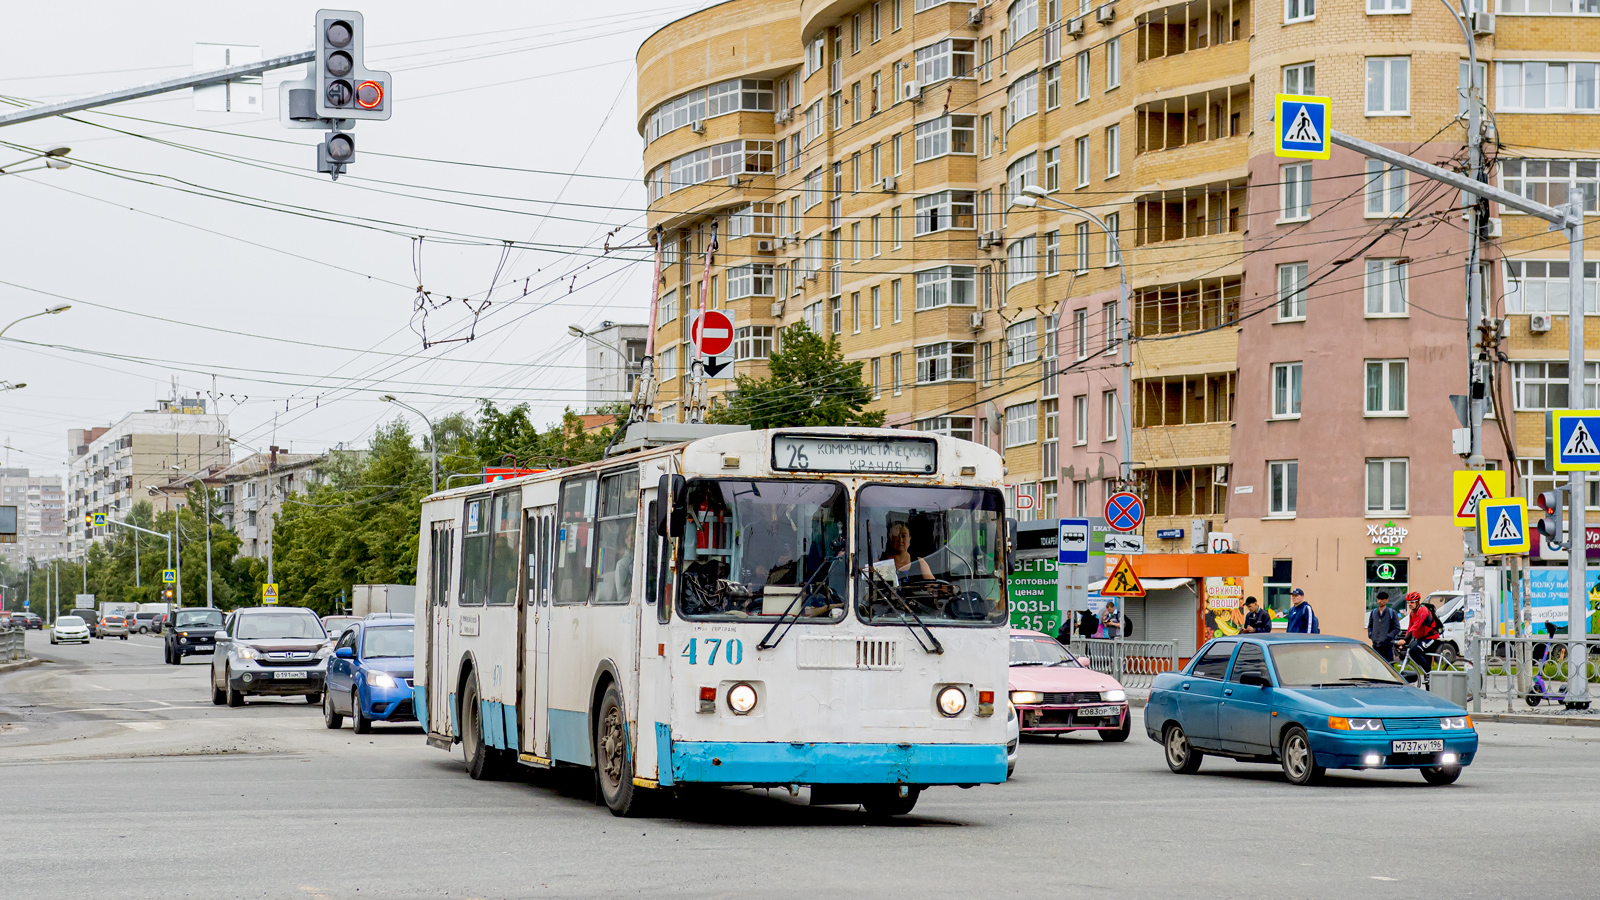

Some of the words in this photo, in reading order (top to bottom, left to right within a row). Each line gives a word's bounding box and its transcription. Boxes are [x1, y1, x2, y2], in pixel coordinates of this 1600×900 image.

[786, 444, 809, 469] 26
[817, 443, 931, 457] КОММУНИСТИЧЕСКАЯ
[1366, 524, 1409, 536] Жизнь
[1371, 536, 1406, 547] март
[1586, 531, 1600, 543] Ур
[1014, 558, 1059, 572] ВЕТЫ
[1014, 578, 1059, 586] оптовым
[1532, 581, 1555, 590] полку
[1015, 589, 1045, 597] ценам
[1208, 586, 1242, 596] ФРУКТЫ
[1210, 599, 1239, 610] ОВОЩИ
[1020, 615, 1044, 632] 35
[681, 638, 743, 665] 470
[1395, 741, 1428, 751] М737КУ
[1430, 740, 1442, 748] 196
